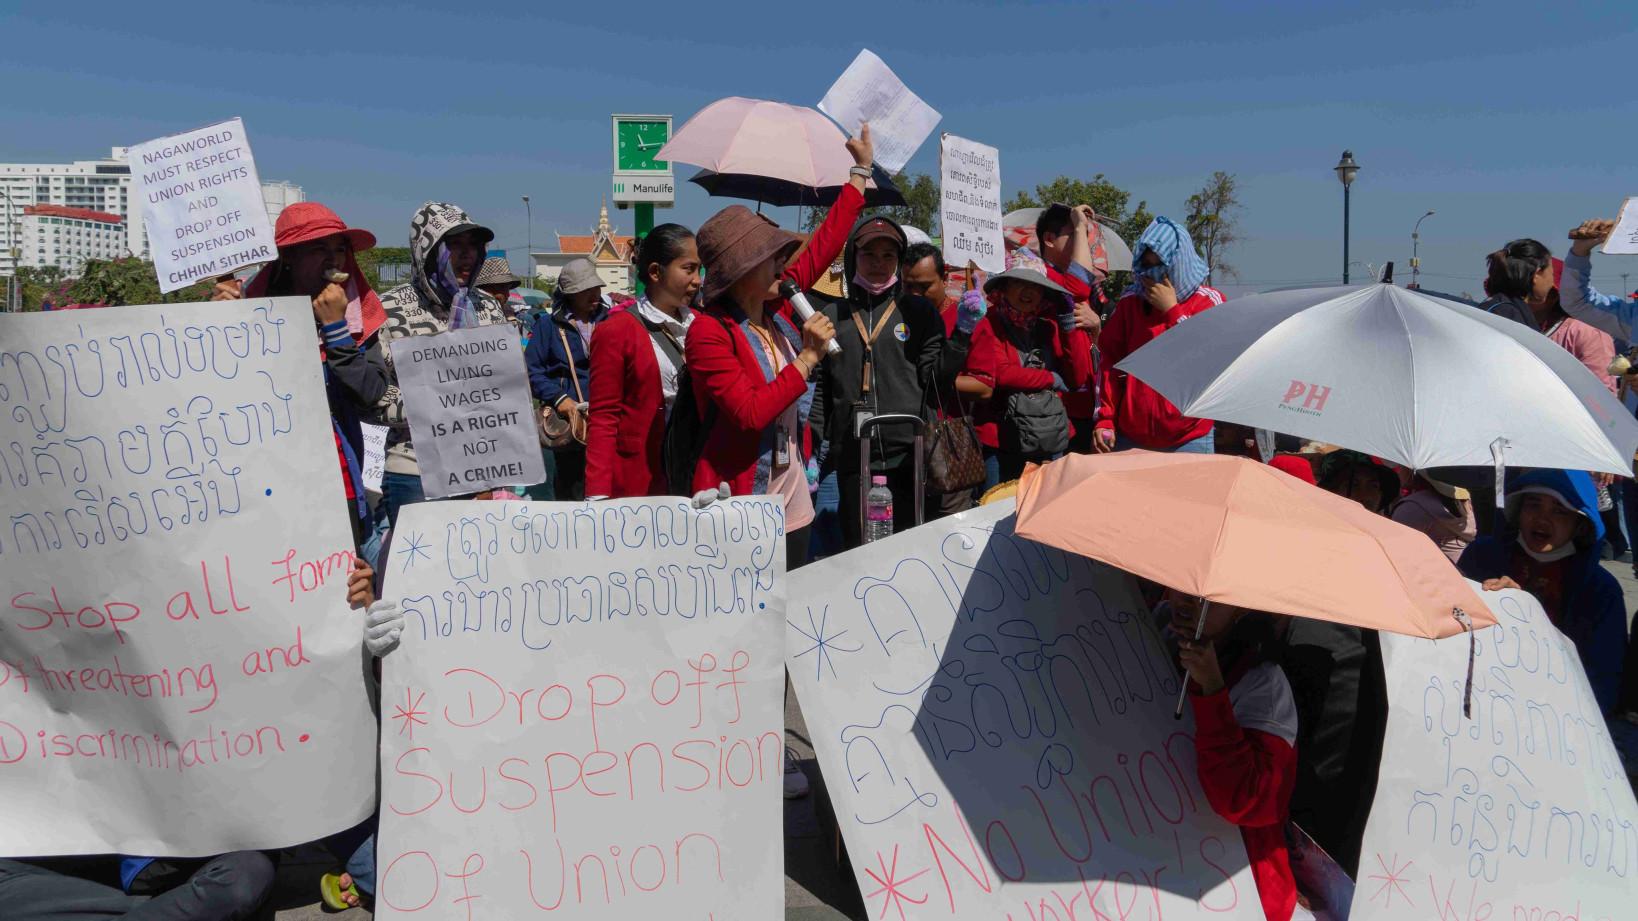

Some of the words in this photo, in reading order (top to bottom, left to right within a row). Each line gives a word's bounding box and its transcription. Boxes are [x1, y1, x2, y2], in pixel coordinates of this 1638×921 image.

[142, 130, 233, 165] NAGAWORLD
[143, 164, 182, 185] MUST
[186, 147, 242, 173] RESPECT
[148, 181, 195, 204] UNION
[199, 166, 248, 190] RIGHTS
[633, 184, 673, 193] Manulife
[187, 196, 218, 213] AND
[175, 219, 212, 239] DROP
[216, 210, 242, 227] OFF
[171, 227, 256, 261] SUSPENSION
[169, 261, 216, 284] CHHIM
[219, 245, 270, 268] SITHAR
[412, 338, 508, 363] DEMANDING
[437, 364, 493, 384] LIVING
[438, 387, 501, 409] WAGES
[1281, 380, 1332, 411] PH
[431, 424, 447, 438] IS
[451, 420, 464, 434] A
[468, 411, 519, 431] RIGHT
[463, 439, 498, 457] NOT
[448, 472, 460, 486] A
[464, 461, 524, 482] CRIME!
[11, 586, 140, 644] Stop
[166, 555, 251, 621] all
[242, 626, 311, 677] and
[444, 668, 626, 753] Drop
[389, 732, 782, 833] Suspension
[922, 799, 1026, 914] No
[382, 851, 484, 921] Of
[520, 833, 725, 911] Union
